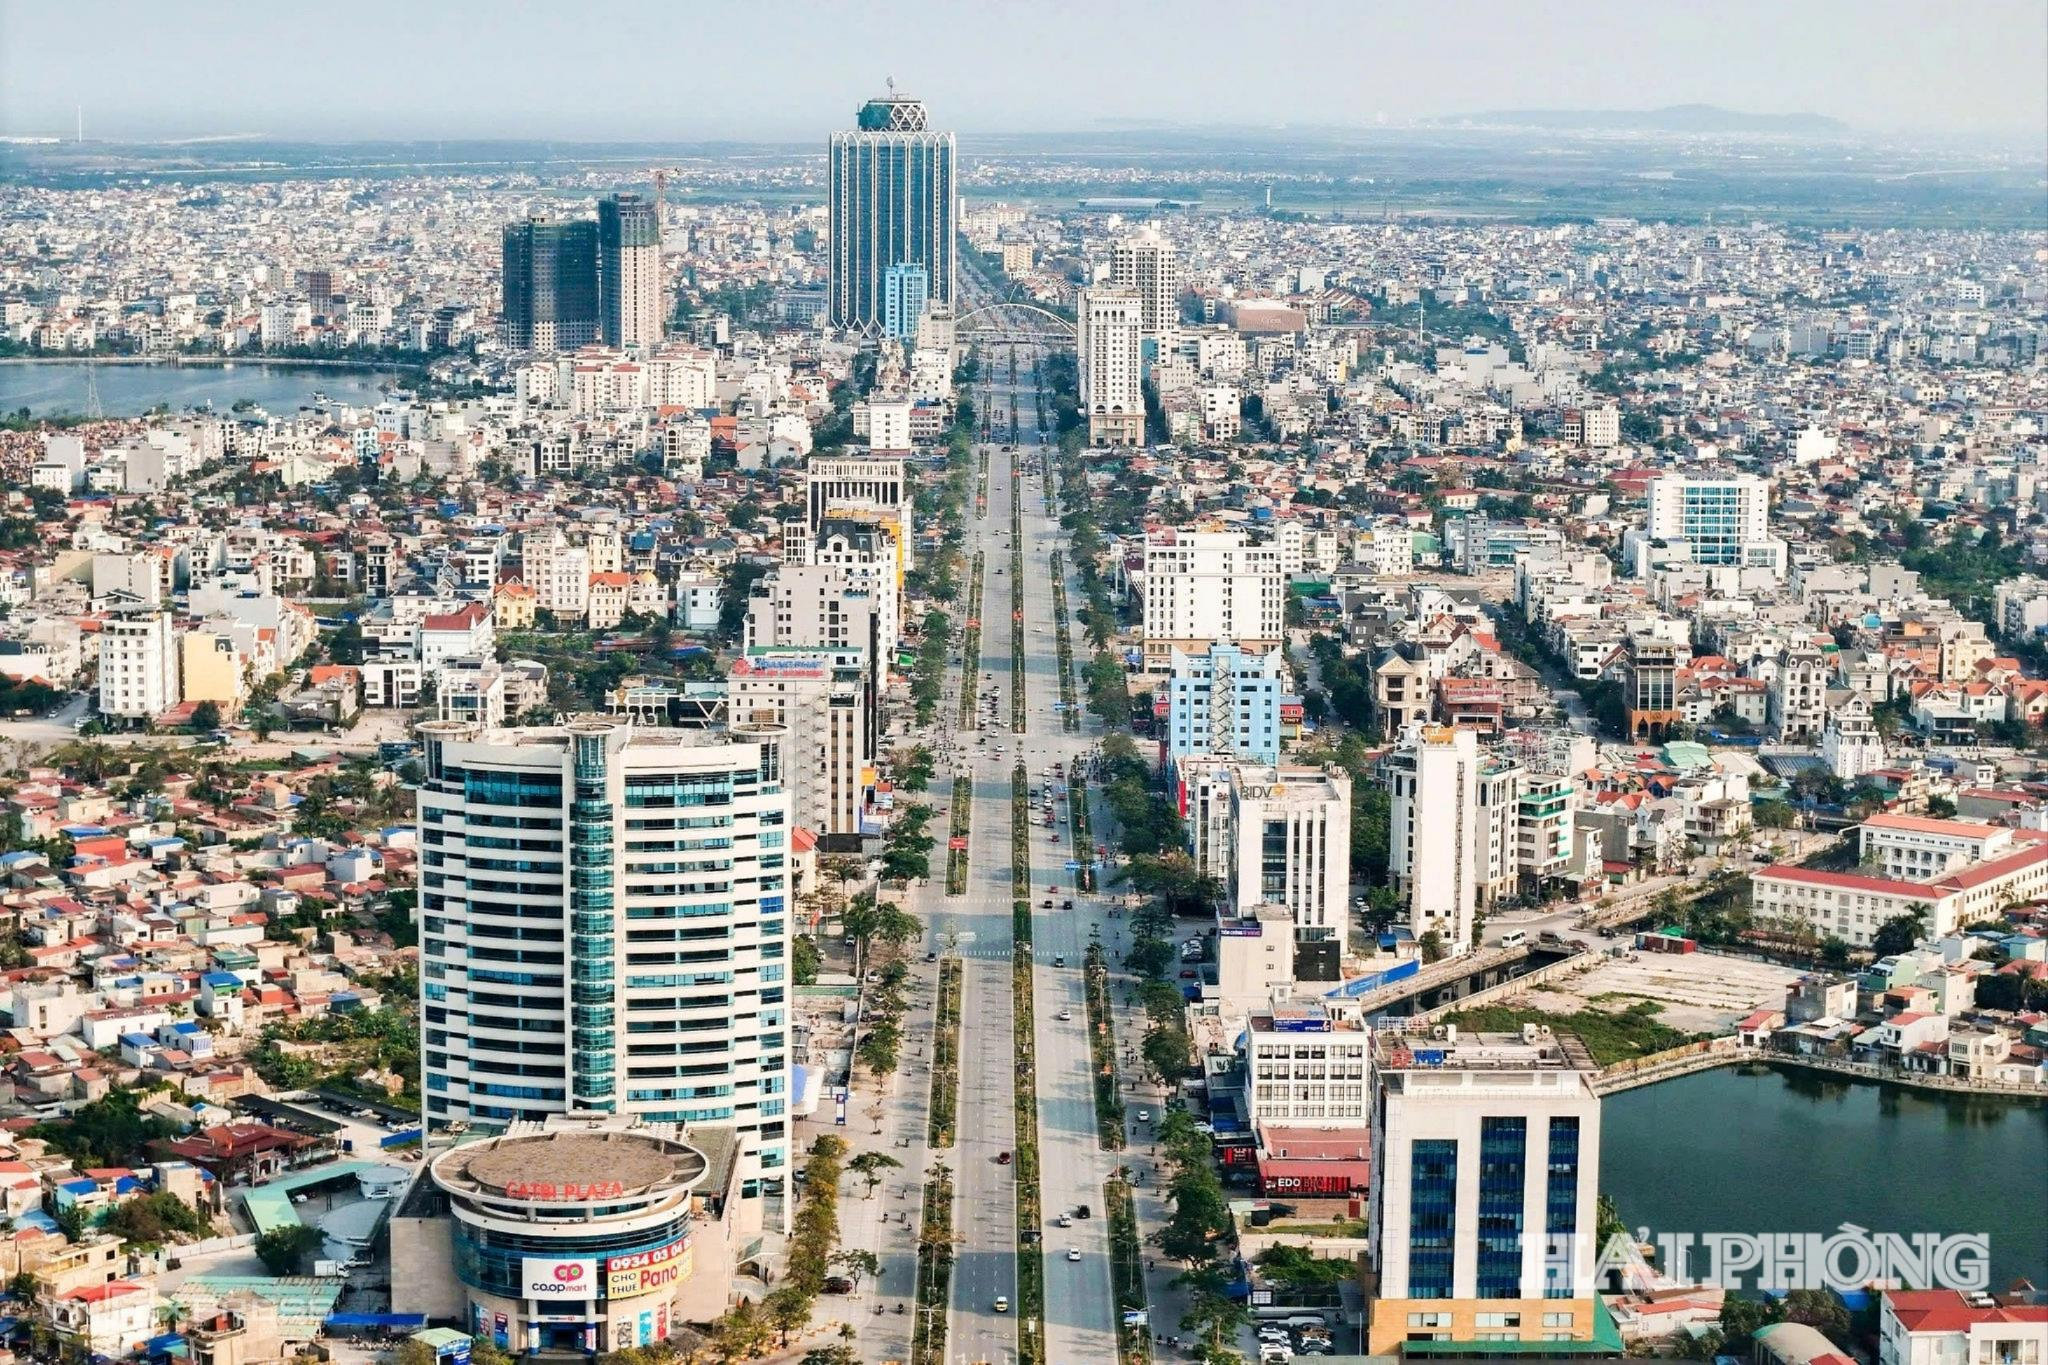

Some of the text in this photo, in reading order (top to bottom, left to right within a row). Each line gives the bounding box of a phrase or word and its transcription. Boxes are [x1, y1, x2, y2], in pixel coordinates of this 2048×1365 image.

[1240, 786, 1272, 800] BIDV
[564, 1181, 623, 1198] PLAZA
[1278, 1178, 1301, 1187] EDO
[610, 1253, 650, 1271] 0934
[611, 1273, 637, 1283] CHO
[640, 1265, 678, 1290] Pano
